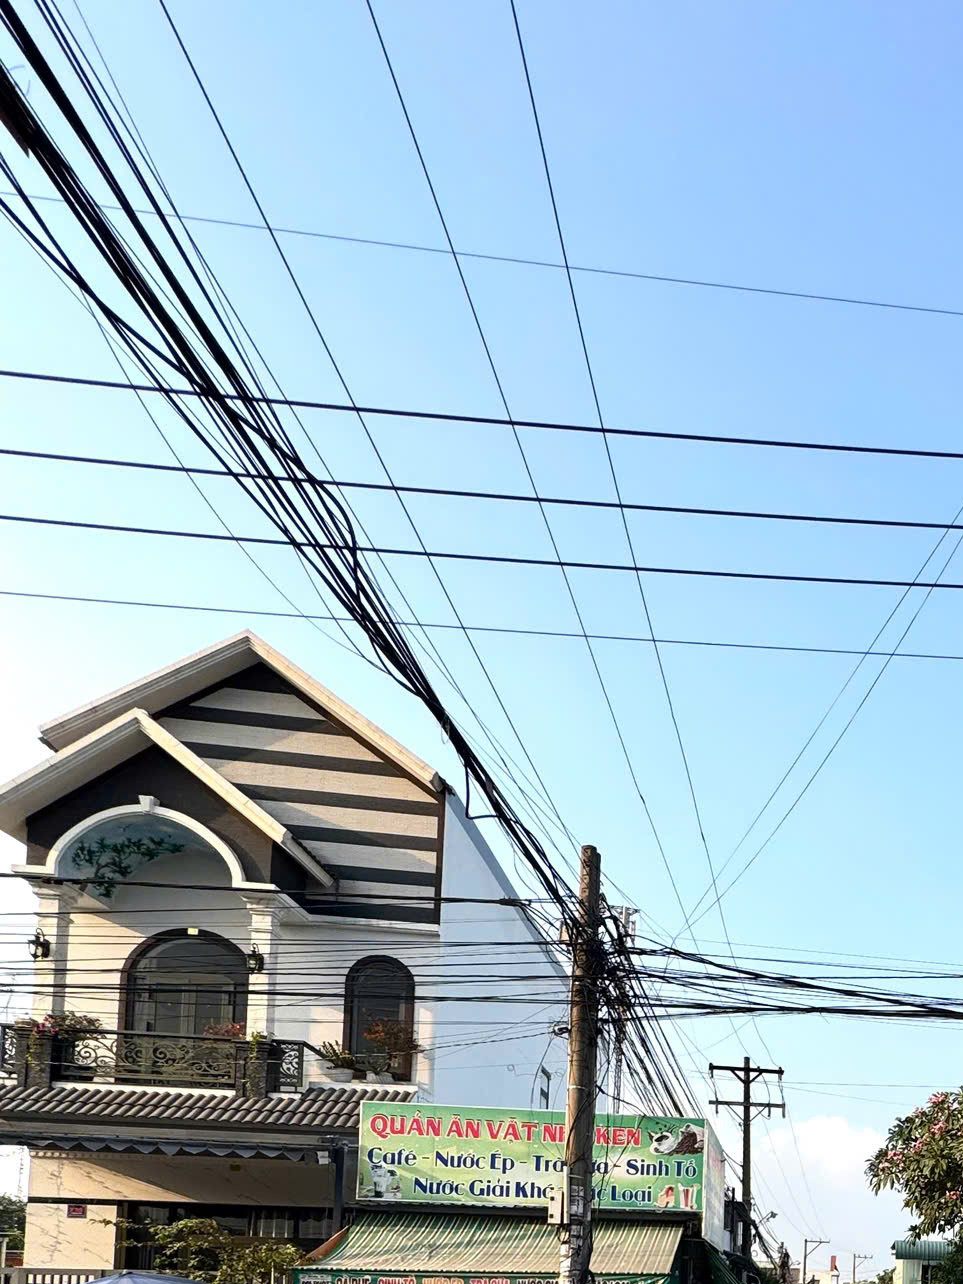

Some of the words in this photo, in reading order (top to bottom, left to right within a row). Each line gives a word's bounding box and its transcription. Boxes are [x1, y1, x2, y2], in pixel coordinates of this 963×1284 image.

[370, 1110, 442, 1139] QUÁN
[446, 1114, 481, 1138] ĂN
[485, 1117, 538, 1144] VẶT
[542, 1123, 568, 1143] NH
[595, 1127, 642, 1146] KEN
[368, 1147, 417, 1167] Café
[435, 1150, 487, 1169] Nước
[490, 1151, 515, 1174] Ép
[626, 1158, 670, 1177] Sinh
[674, 1159, 698, 1178] Tố
[413, 1177, 465, 1196] Nước
[469, 1177, 511, 1198] Giải
[515, 1181, 553, 1199] Khá
[611, 1184, 652, 1204] Loại
